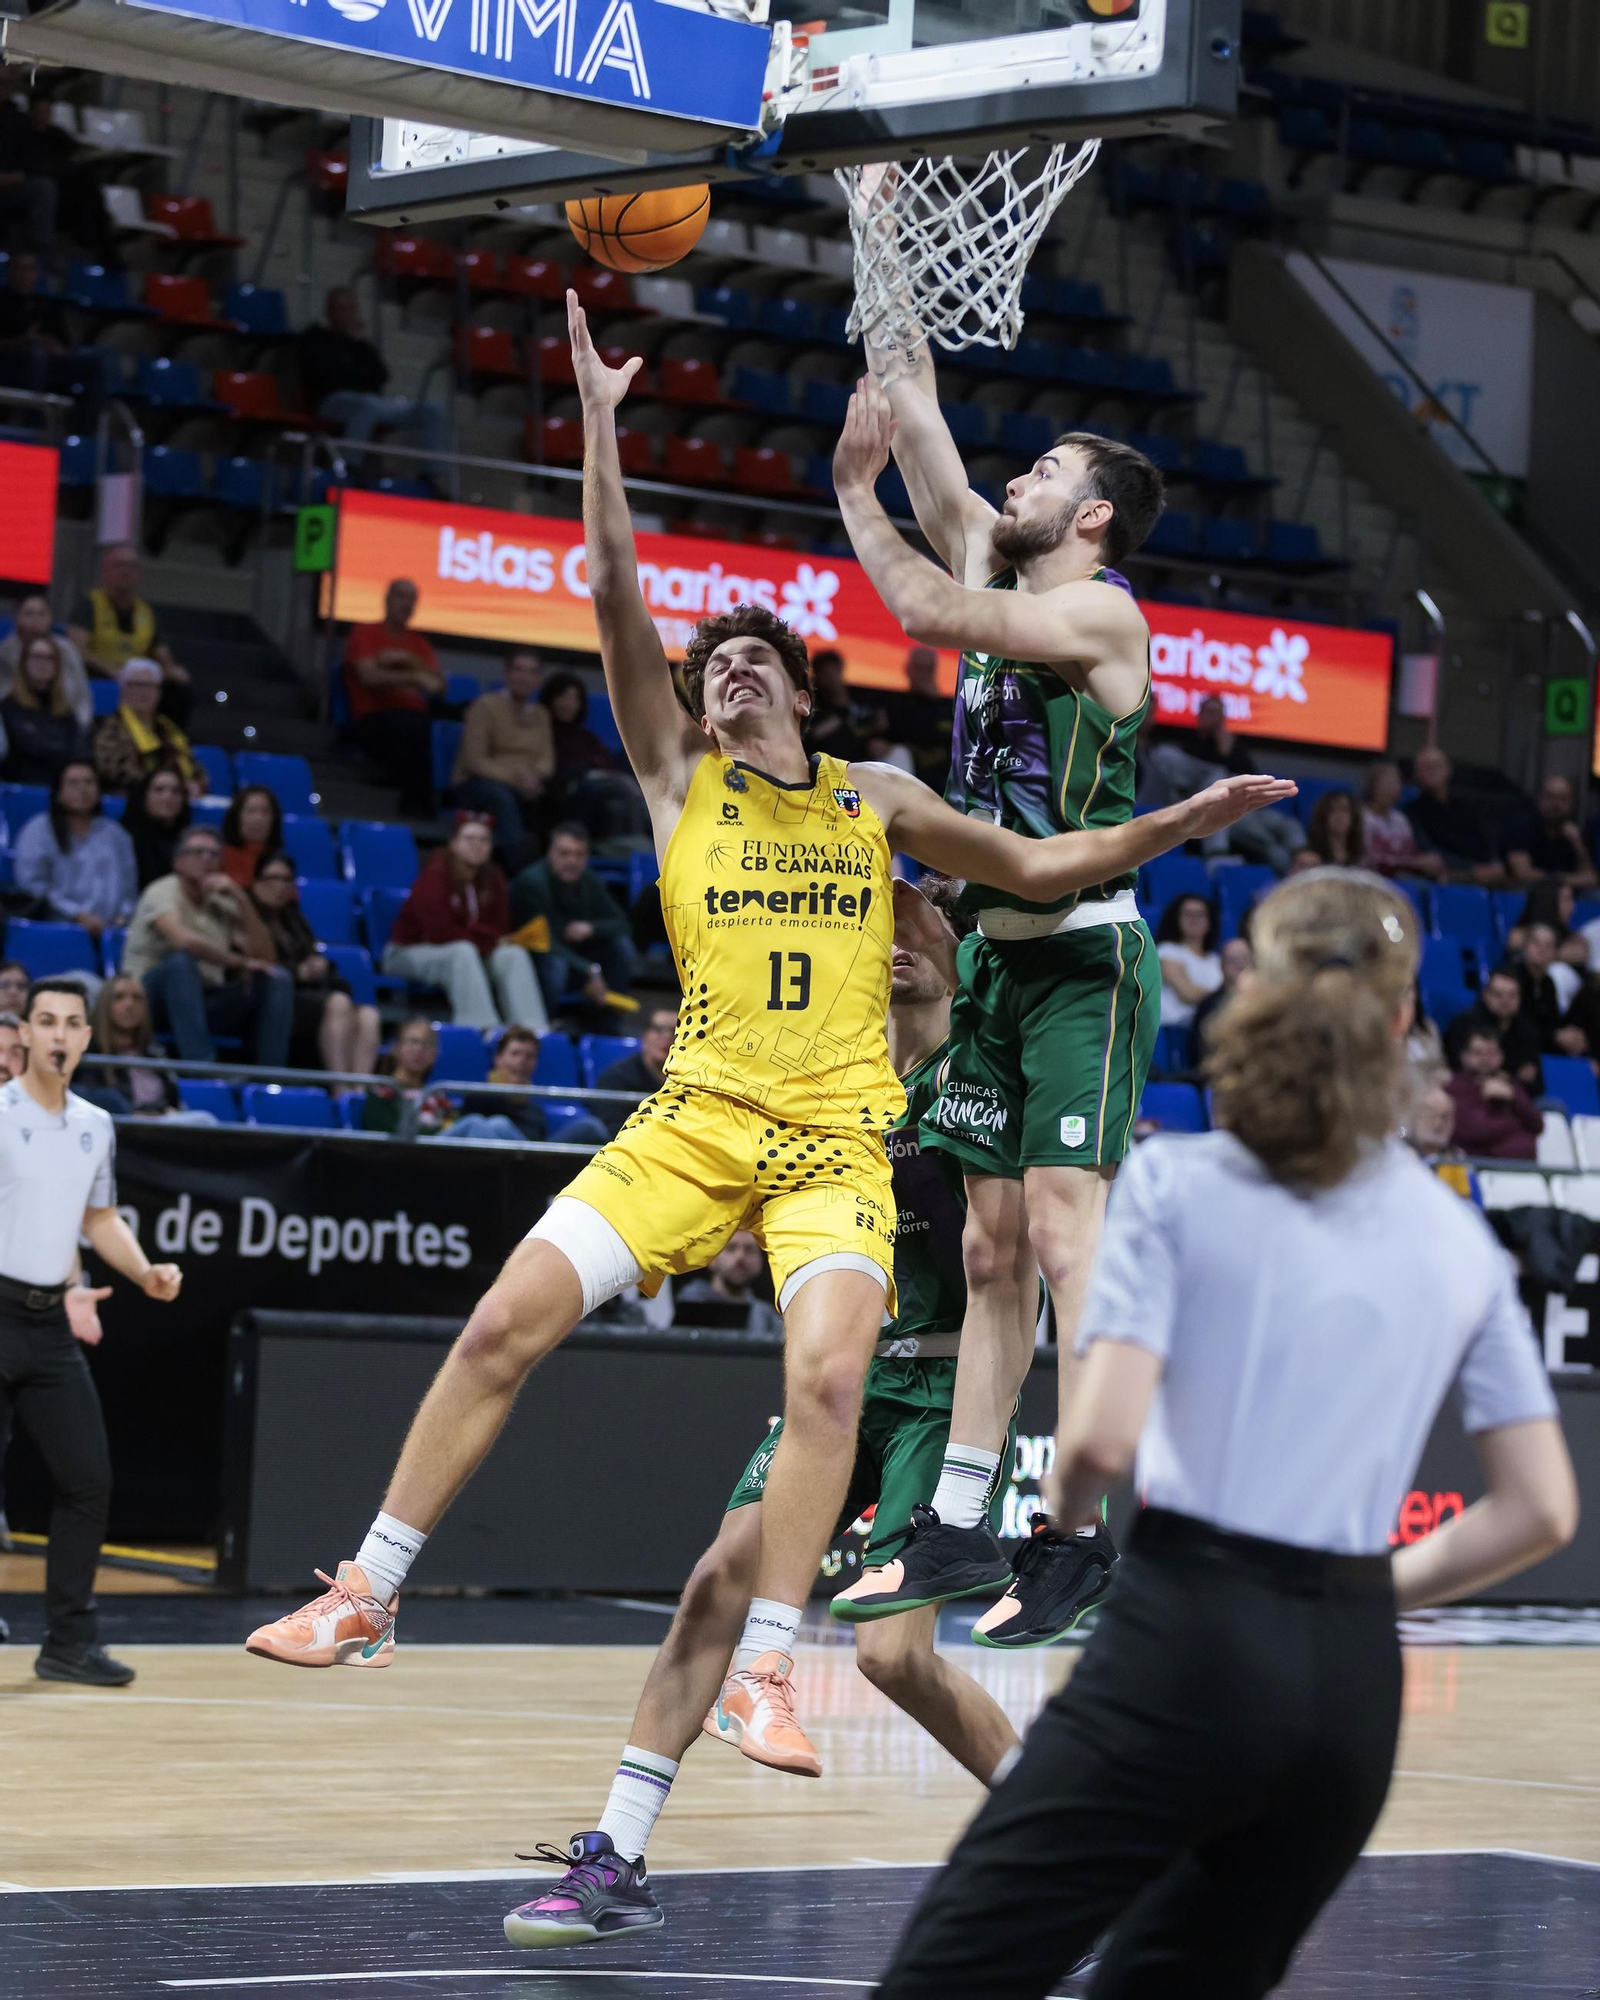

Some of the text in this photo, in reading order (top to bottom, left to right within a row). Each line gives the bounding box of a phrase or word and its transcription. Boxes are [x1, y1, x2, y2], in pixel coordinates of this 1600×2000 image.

[305, 516, 325, 556] P
[437, 525, 778, 615] Islas Cnarias
[1150, 627, 1255, 686] arias
[833, 789, 858, 799] LIGA
[742, 839, 875, 864] FUNDACIÓN
[740, 856, 873, 881] CB CANARIAS
[706, 914, 773, 930] despierta
[766, 951, 812, 1011] 13
[946, 1081, 998, 1099] CLINICAS
[941, 1127, 994, 1147] DENTAL
[897, 1209, 915, 1222] rín
[155, 1193, 223, 1255] de
[238, 1196, 473, 1277] Deportes
